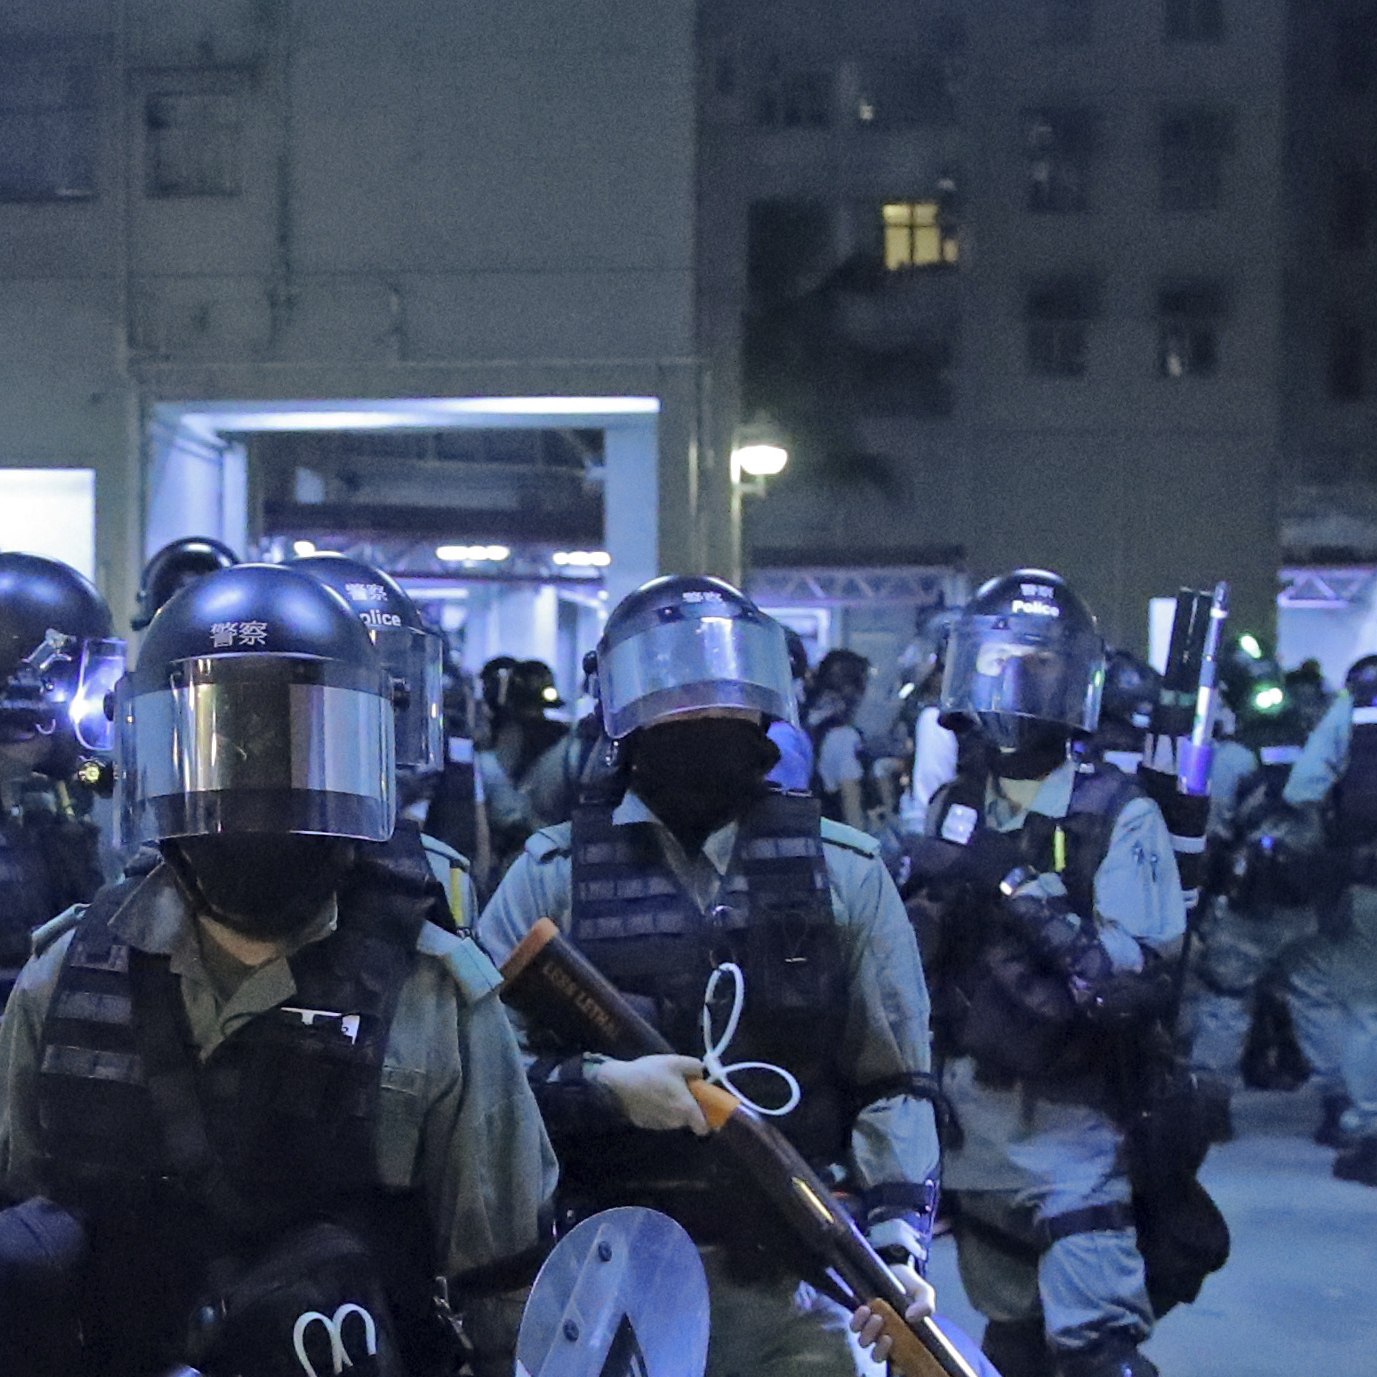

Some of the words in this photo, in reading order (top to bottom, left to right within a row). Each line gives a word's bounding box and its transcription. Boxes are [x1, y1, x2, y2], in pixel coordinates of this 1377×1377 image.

[1012, 600, 1060, 617] Police
[359, 609, 402, 627] olice
[209, 620, 268, 648] 警察
